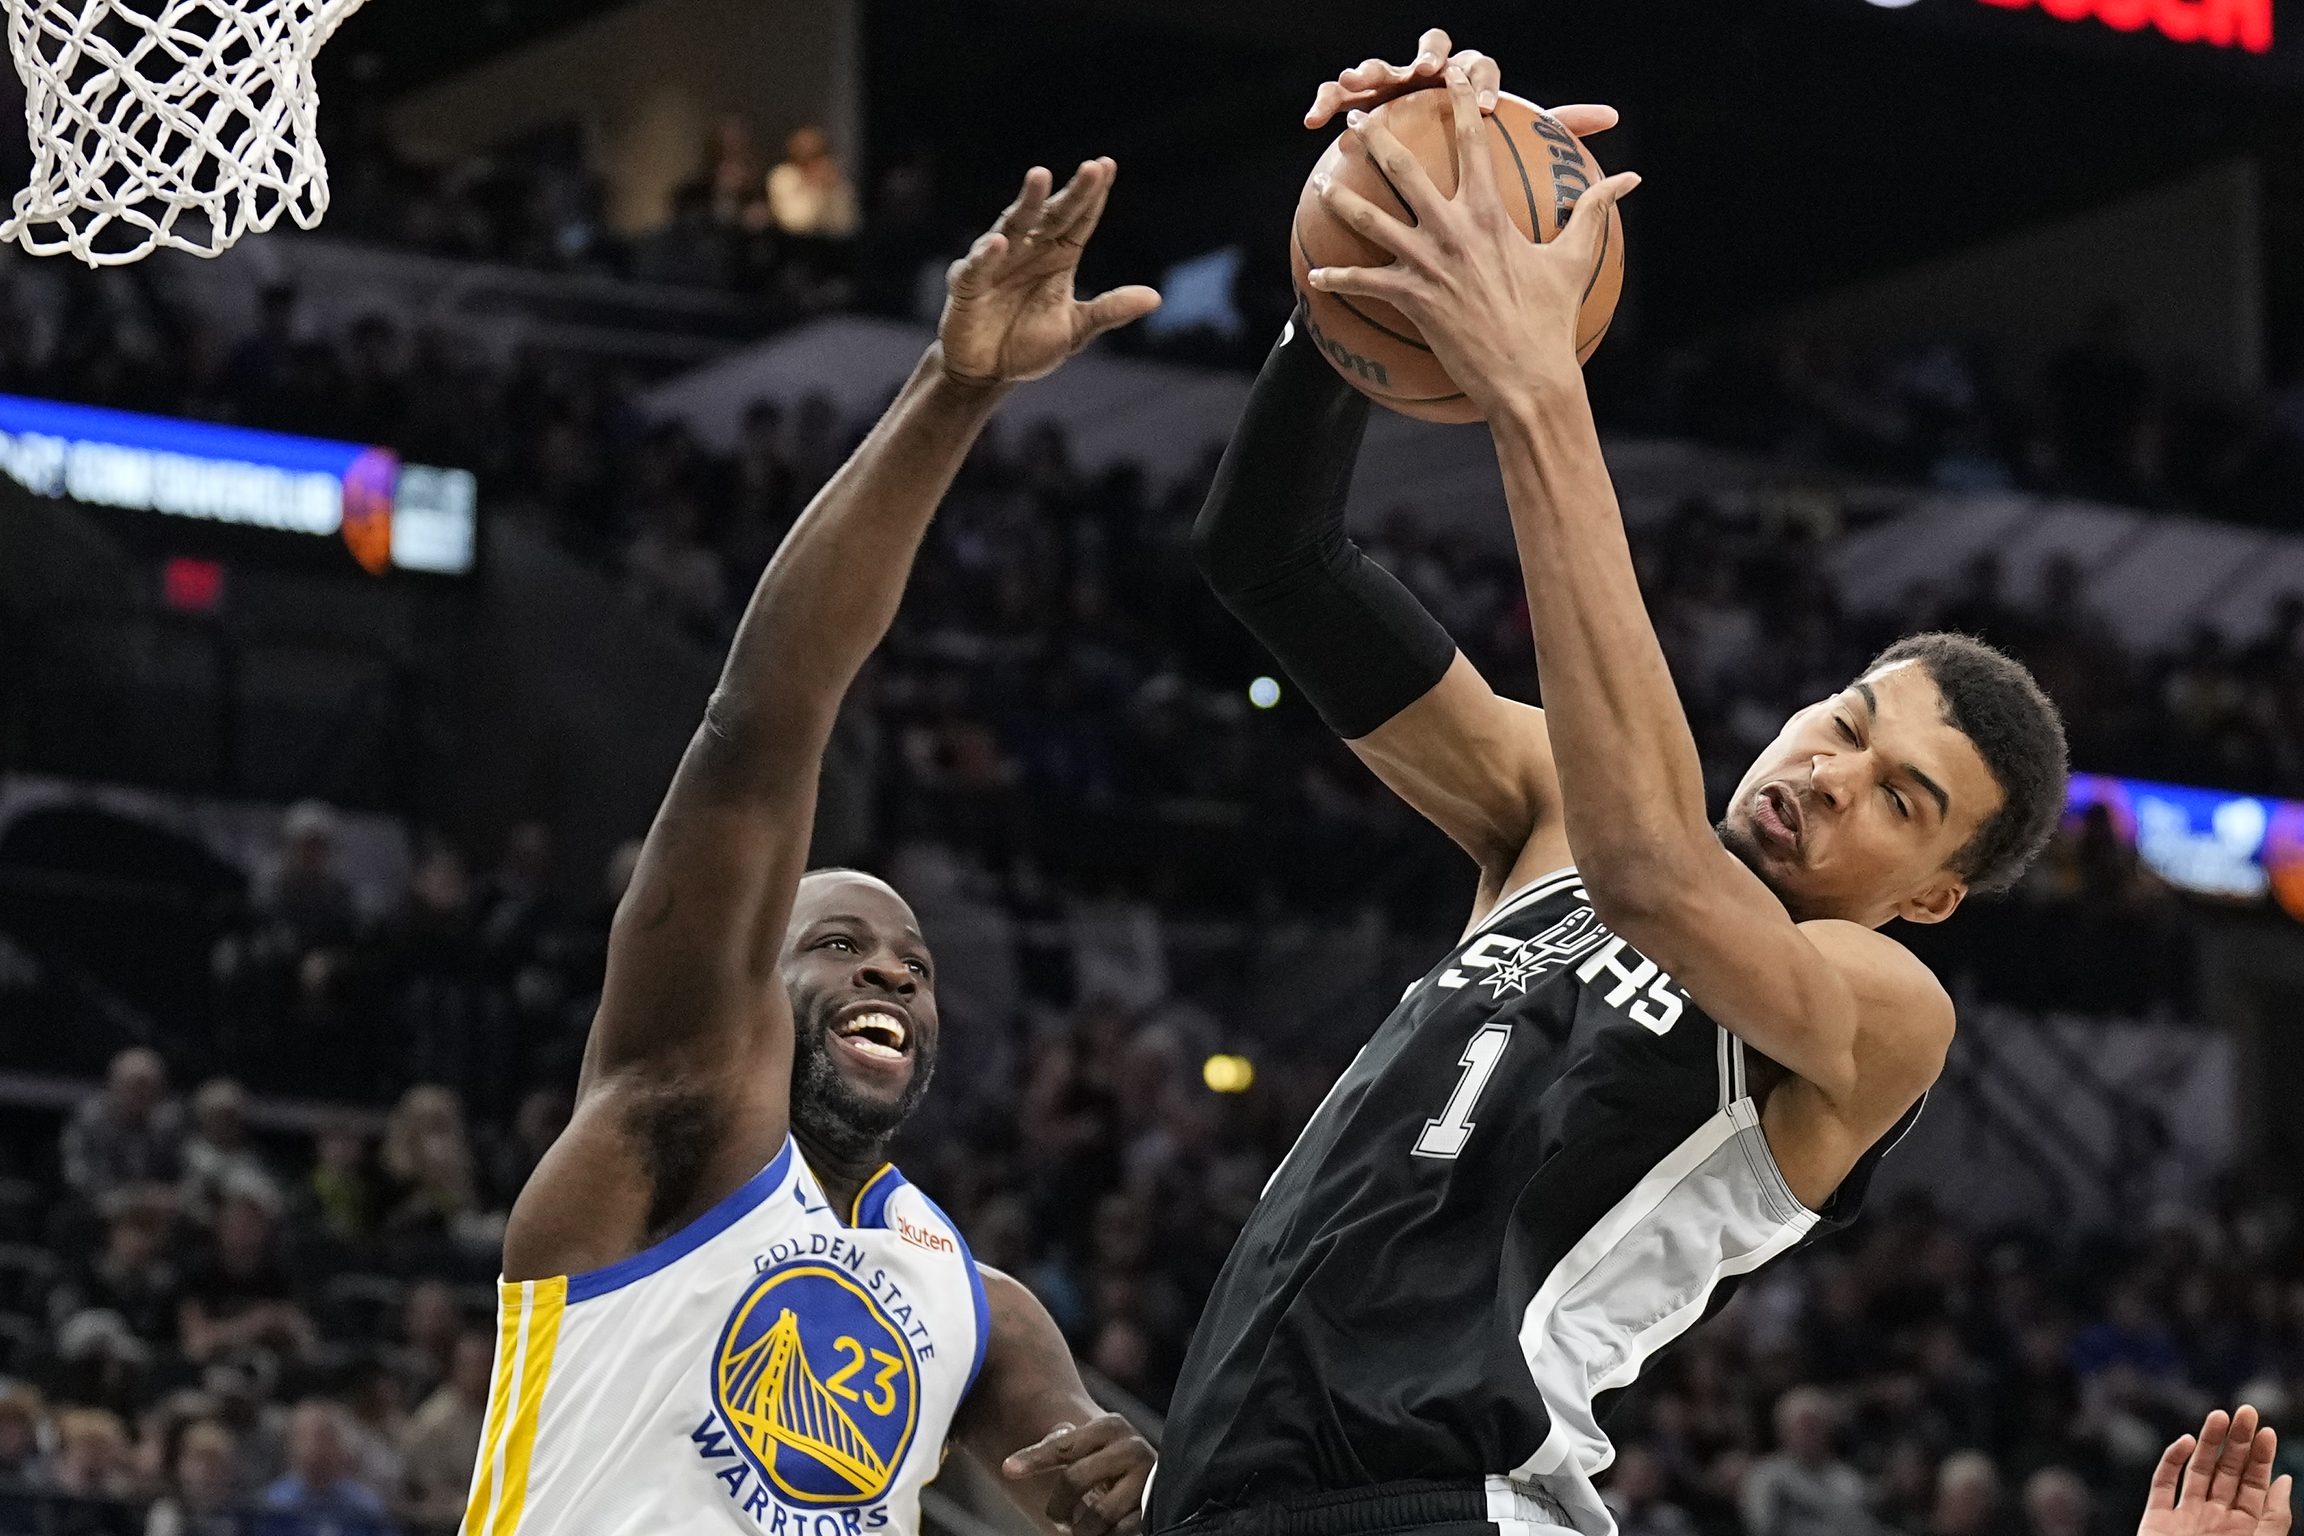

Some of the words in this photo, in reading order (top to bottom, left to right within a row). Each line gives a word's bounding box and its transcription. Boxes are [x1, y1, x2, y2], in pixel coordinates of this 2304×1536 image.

[1411, 1023, 1512, 1160] 1
[896, 1214, 954, 1254] akuten
[753, 1233, 866, 1275] GOLDEN
[869, 1269, 935, 1363] STATE
[825, 1335, 904, 1417] 23
[691, 1410, 889, 1536] WARRIORS
